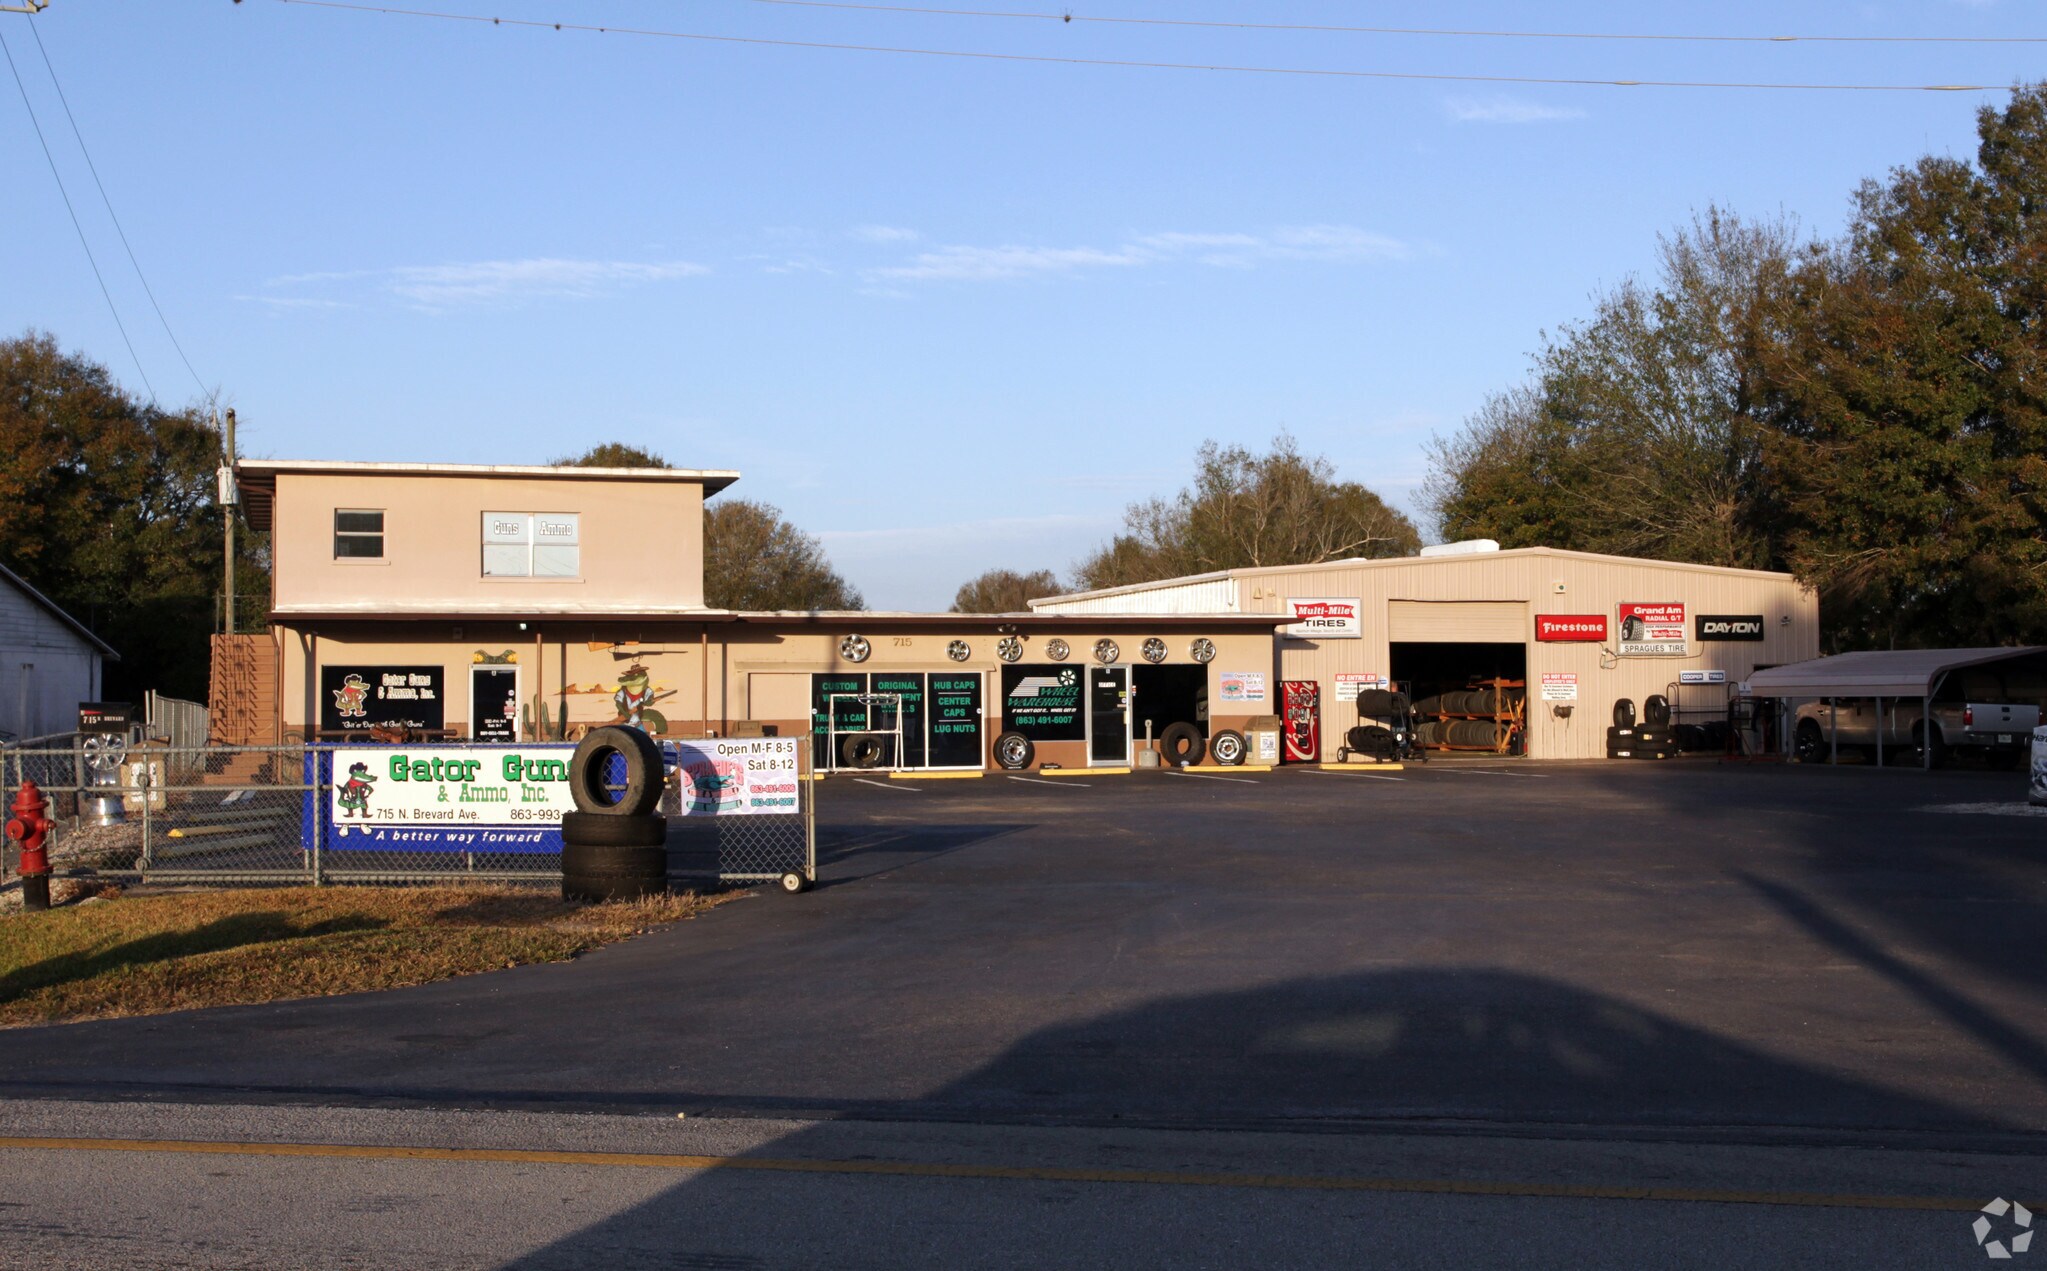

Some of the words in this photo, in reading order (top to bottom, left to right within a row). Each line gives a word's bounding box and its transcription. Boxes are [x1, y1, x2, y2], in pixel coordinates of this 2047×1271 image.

[494, 520, 519, 535] Guns
[539, 521, 572, 536] Ammo
[1298, 606, 1350, 615] Multi-Mile
[1634, 606, 1664, 614] Grand
[1666, 606, 1682, 614] Am
[1305, 619, 1346, 627] TIRES
[1542, 622, 1603, 633] Firestone
[1703, 622, 1760, 633] DAYTON
[893, 637, 912, 646] 715
[382, 673, 406, 686] Gator
[408, 673, 431, 686] Guns
[822, 682, 857, 691] CUSTOM
[878, 681, 917, 690] ORIGINAL
[934, 681, 952, 689] HUB
[953, 681, 975, 689] CAPS
[387, 686, 418, 700] Ammo,
[420, 688, 435, 699] Inc.
[1040, 687, 1080, 696] WHEEL
[938, 697, 971, 705] CENTER
[1007, 697, 1077, 707] WAREHOUSE
[943, 708, 966, 717] CAPS
[83, 716, 97, 724] 715
[1015, 716, 1035, 726] (863)
[934, 725, 951, 733] LUG
[953, 724, 976, 733] NUTS
[717, 743, 748, 757] Open
[751, 742, 772, 754] M-F
[775, 742, 793, 753] 8-5
[389, 755, 481, 782] Gator
[748, 759, 766, 771] Sat
[769, 758, 794, 770] 8-12
[437, 784, 450, 802] &
[459, 783, 511, 804] Ammo,
[521, 783, 549, 802] Inc.
[377, 808, 394, 819] 715
[398, 808, 409, 819] N.
[413, 808, 454, 819] Brevard
[458, 808, 480, 820] Ave.
[375, 830, 385, 840] A
[393, 830, 439, 841] better
[446, 833, 475, 843] way
[482, 831, 542, 842] forward
